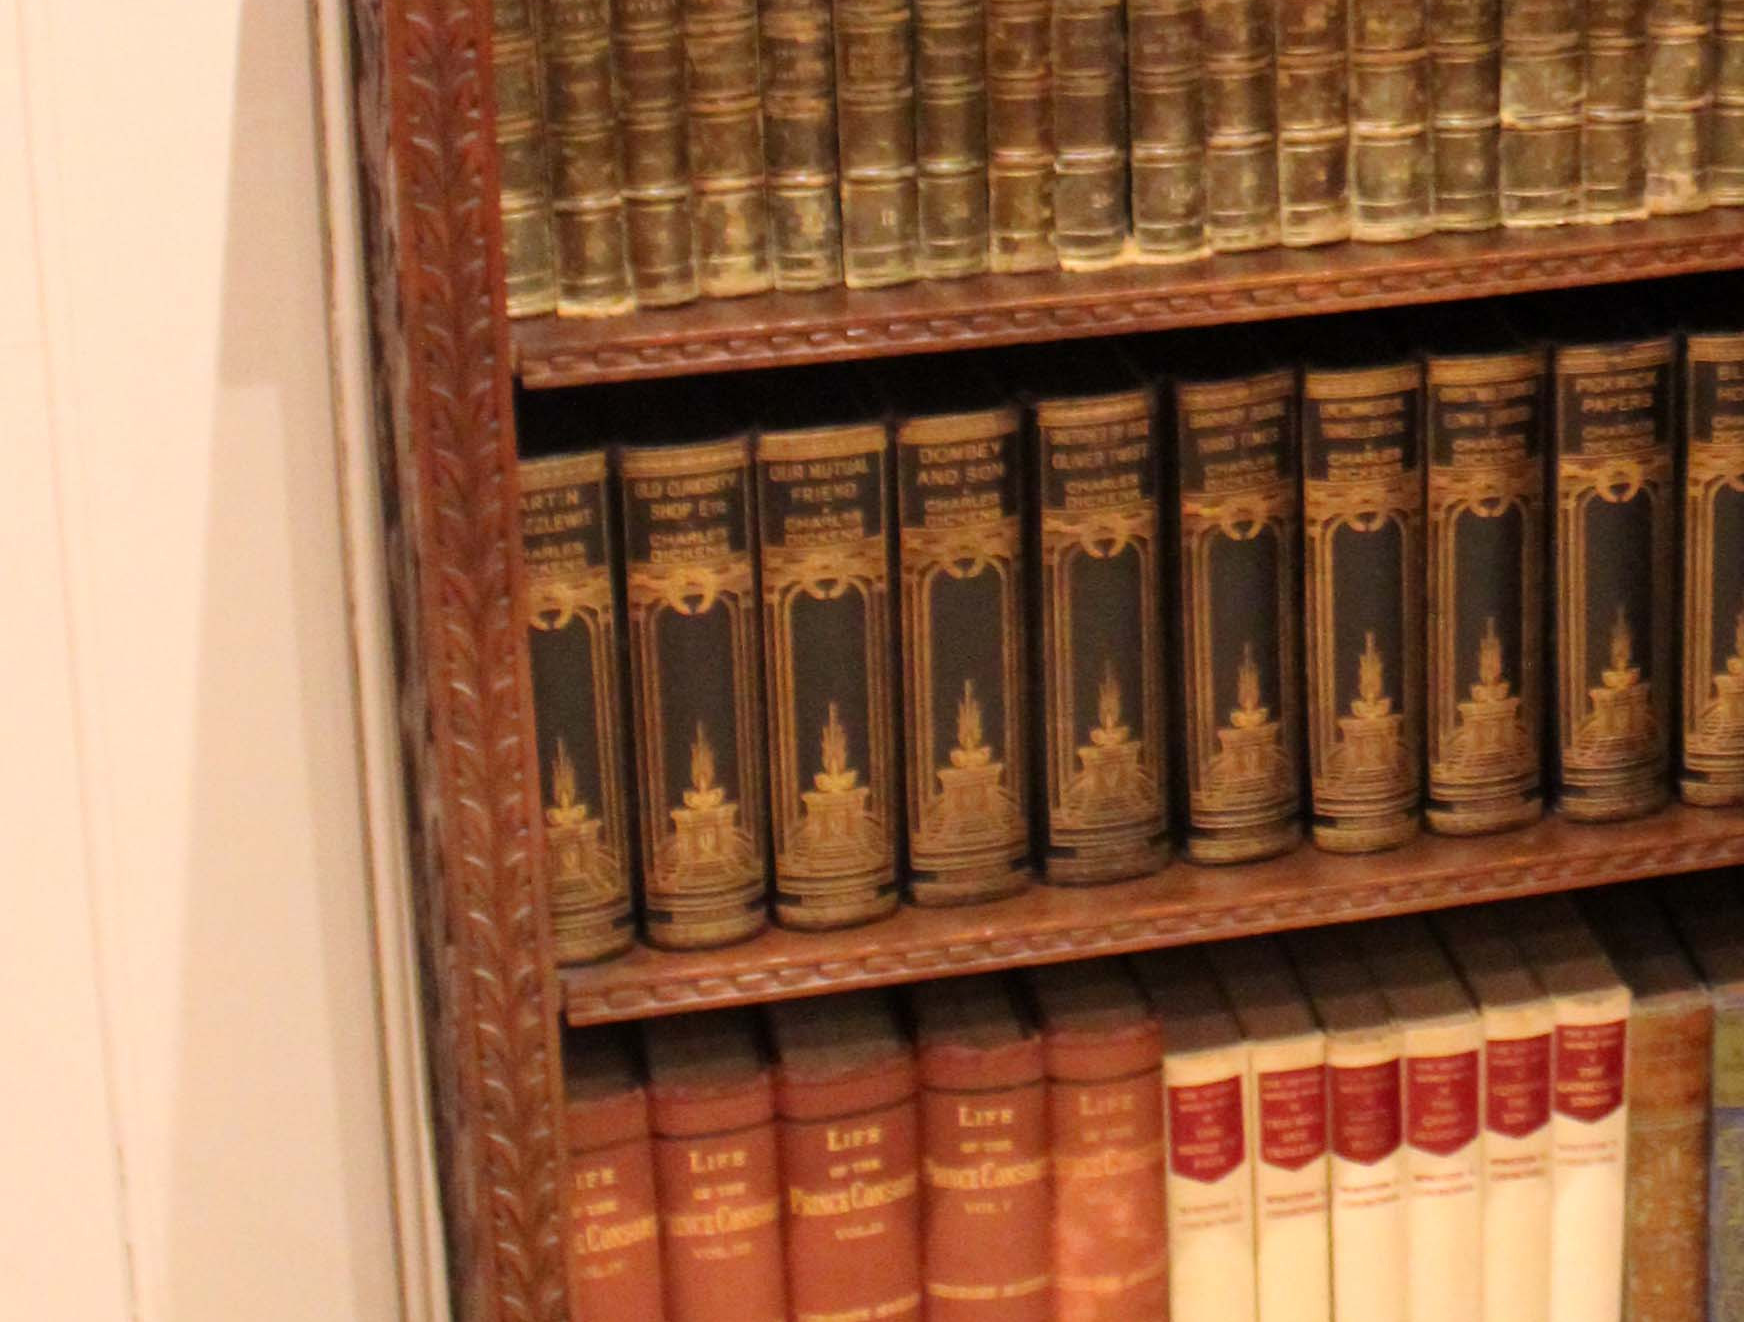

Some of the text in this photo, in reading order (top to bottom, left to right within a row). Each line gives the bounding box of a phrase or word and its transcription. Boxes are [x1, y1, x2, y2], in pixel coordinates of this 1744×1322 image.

[917, 468, 958, 486] AND
[791, 481, 857, 502] FRIEND
[958, 1106, 1013, 1127] LIFE
[827, 1126, 881, 1151] LIFE
[690, 1150, 747, 1174] LIFE
[575, 1166, 616, 1191] IFE
